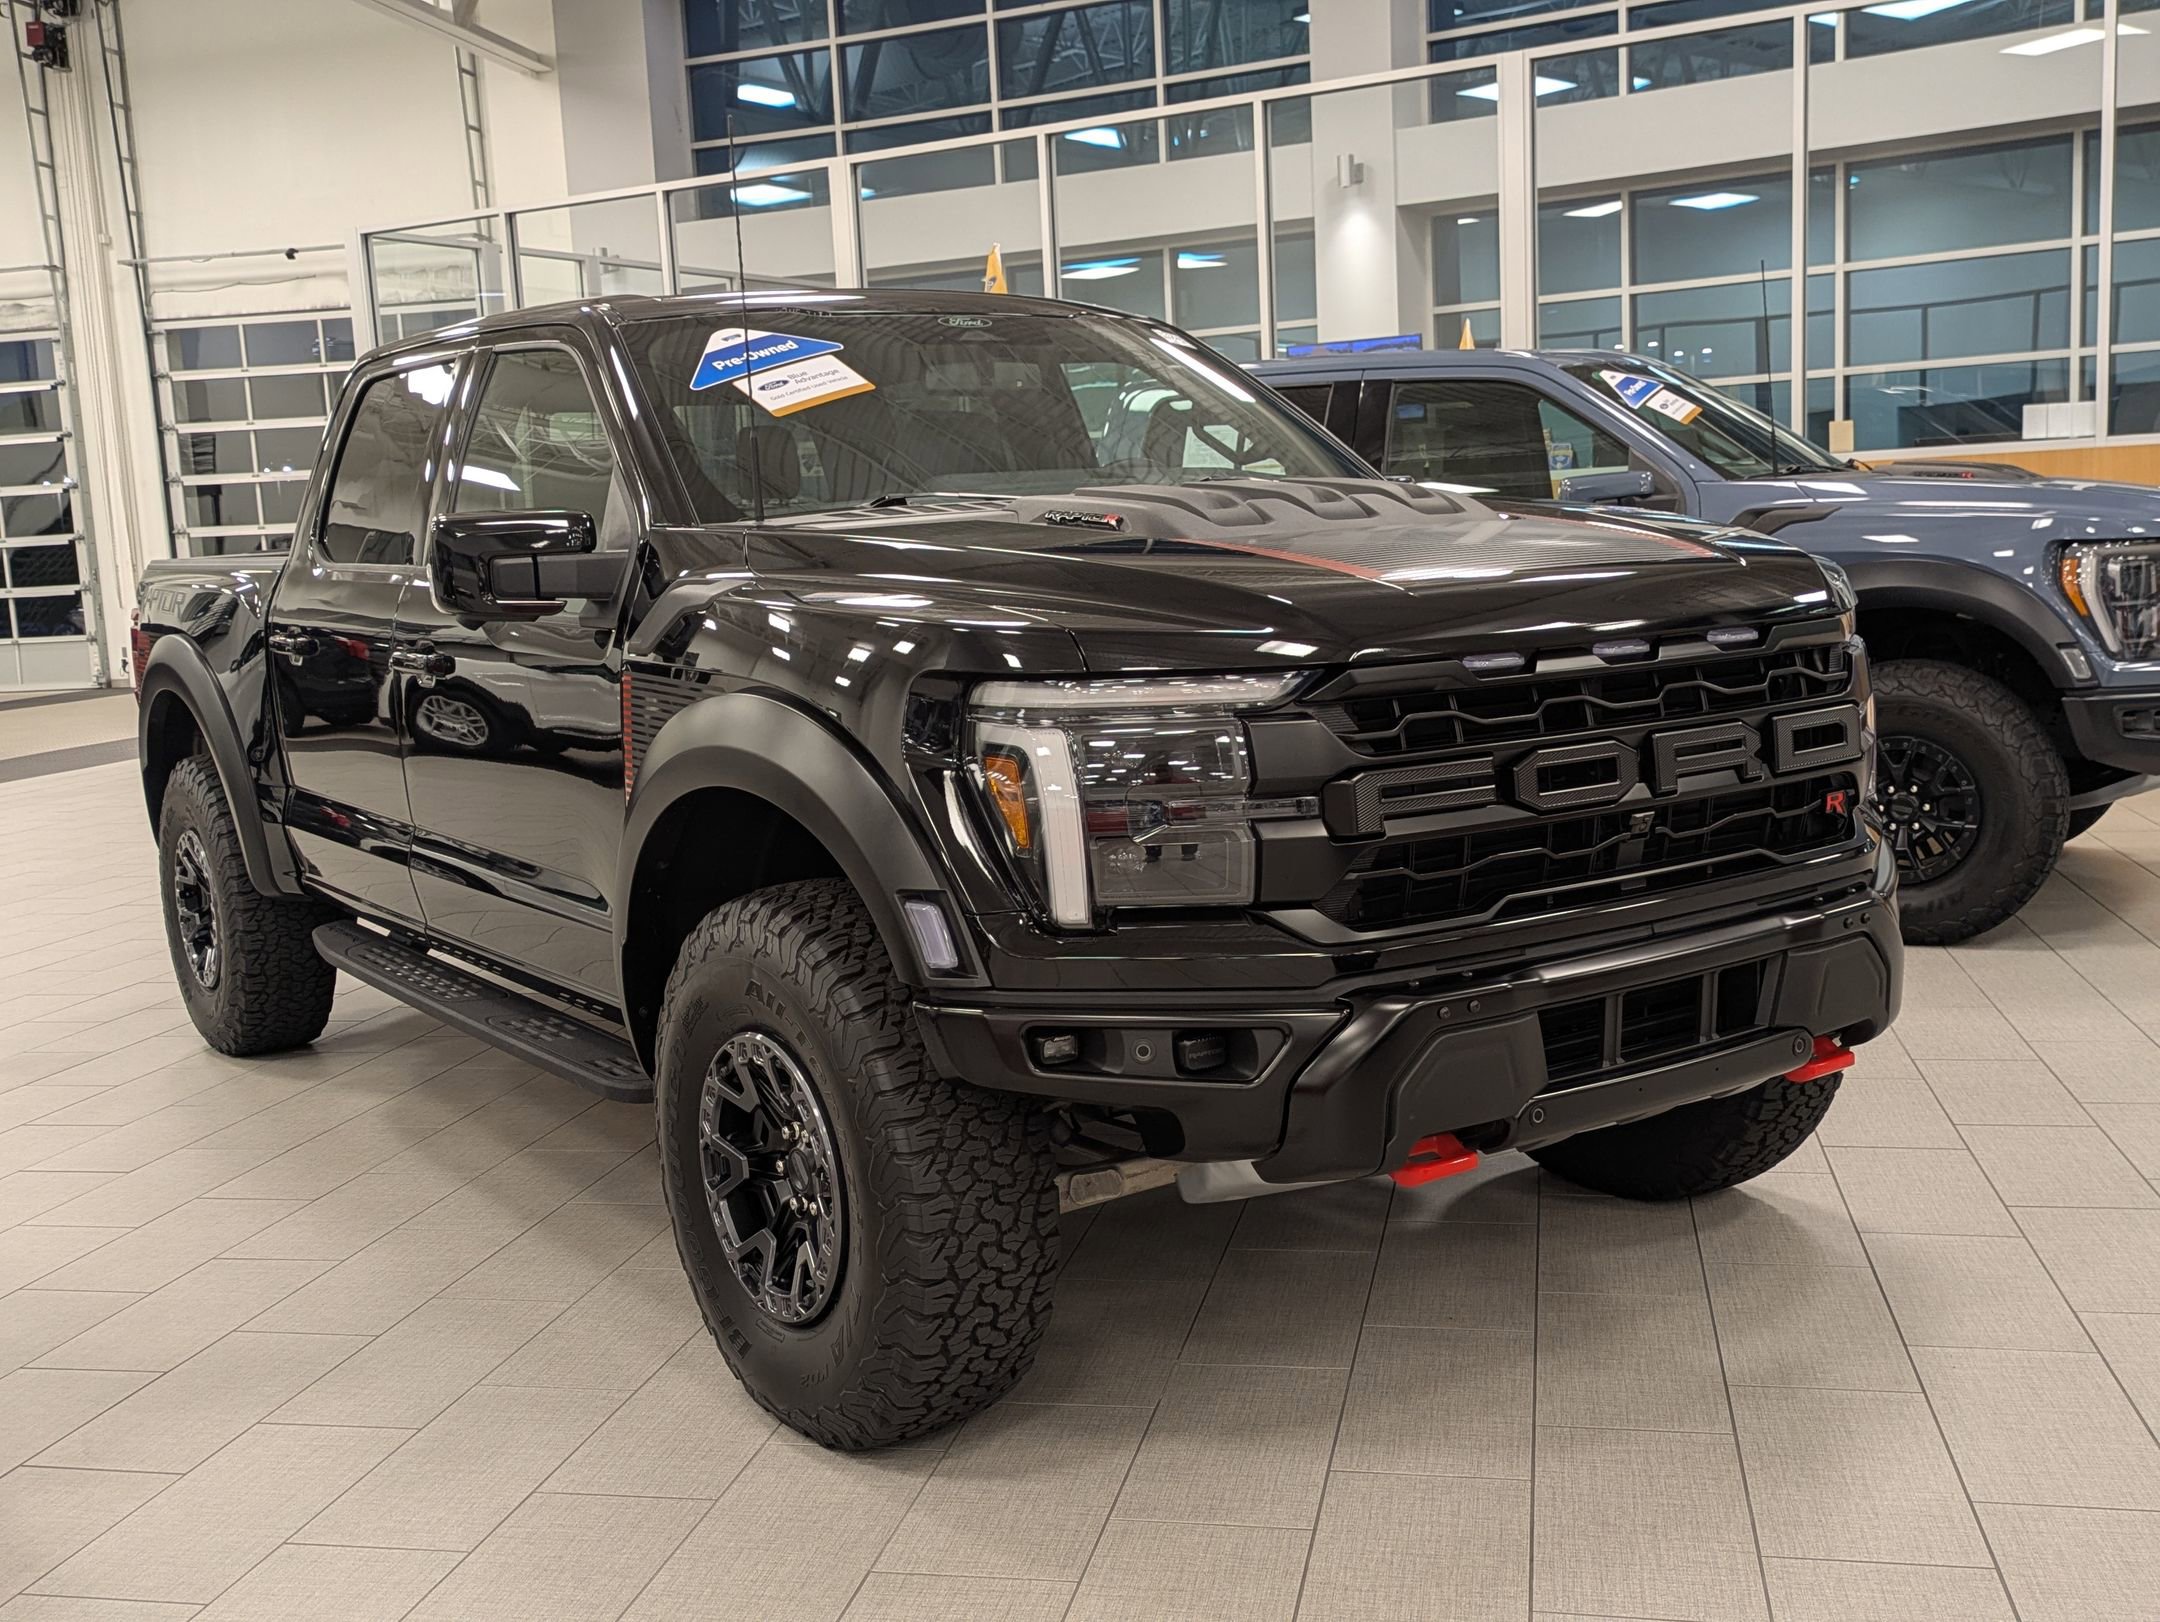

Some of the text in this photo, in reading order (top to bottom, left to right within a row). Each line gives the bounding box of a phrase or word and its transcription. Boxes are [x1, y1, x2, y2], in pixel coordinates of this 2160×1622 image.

[711, 339, 800, 371] Pre-Owned
[764, 369, 840, 391] Ford Advantage
[787, 371, 808, 380] Blue
[1352, 703, 1862, 838] FORD
[1825, 790, 1847, 815] R
[667, 1035, 753, 1361] BFGoodrich
